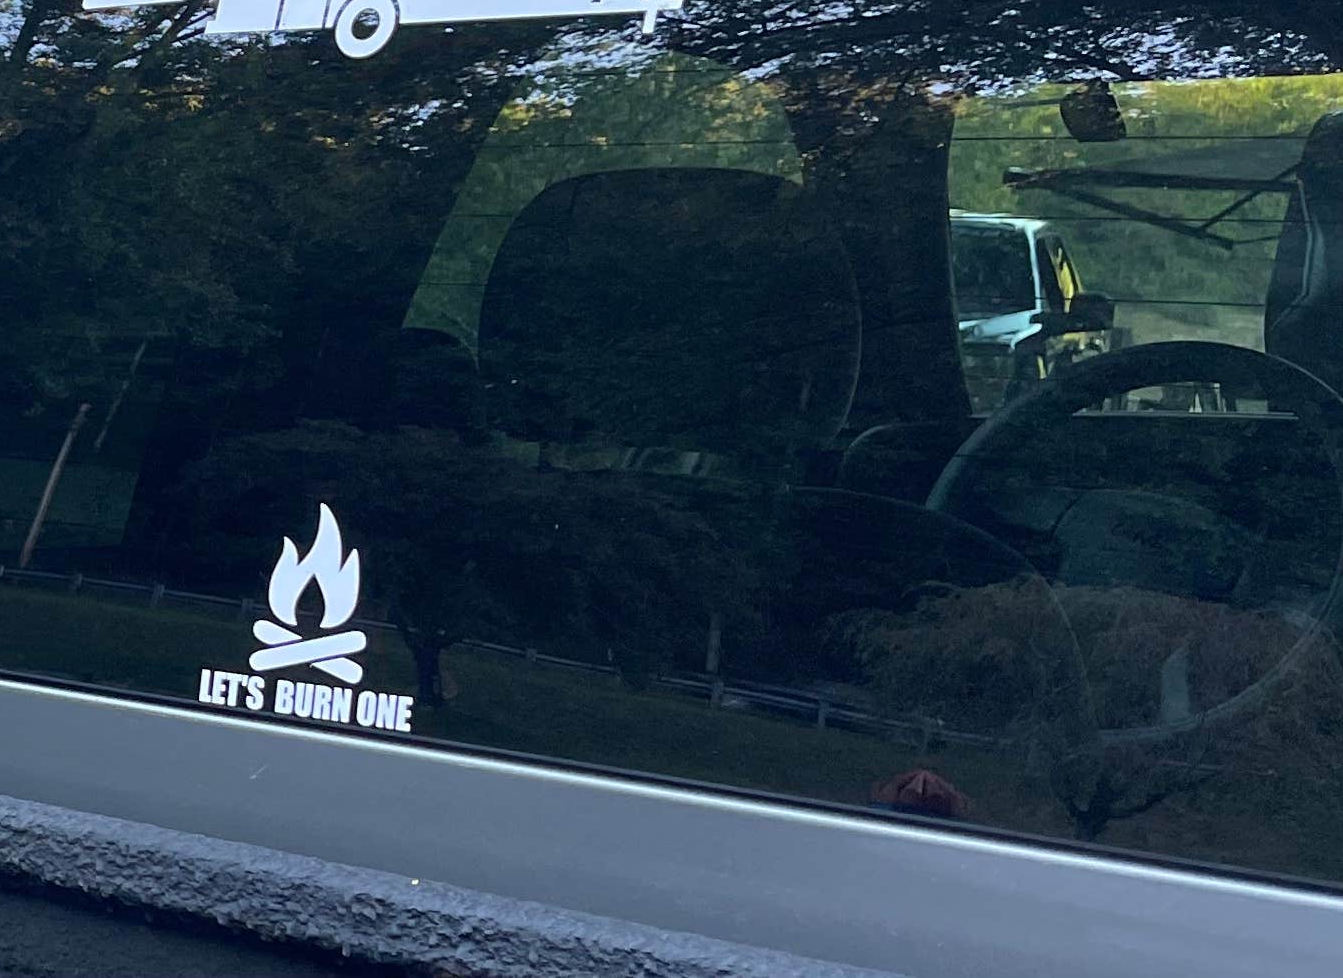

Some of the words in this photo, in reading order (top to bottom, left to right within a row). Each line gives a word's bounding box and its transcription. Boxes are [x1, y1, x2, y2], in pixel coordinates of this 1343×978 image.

[199, 668, 265, 711] LET'S
[274, 679, 353, 723] BURN
[356, 690, 414, 732] ONE
